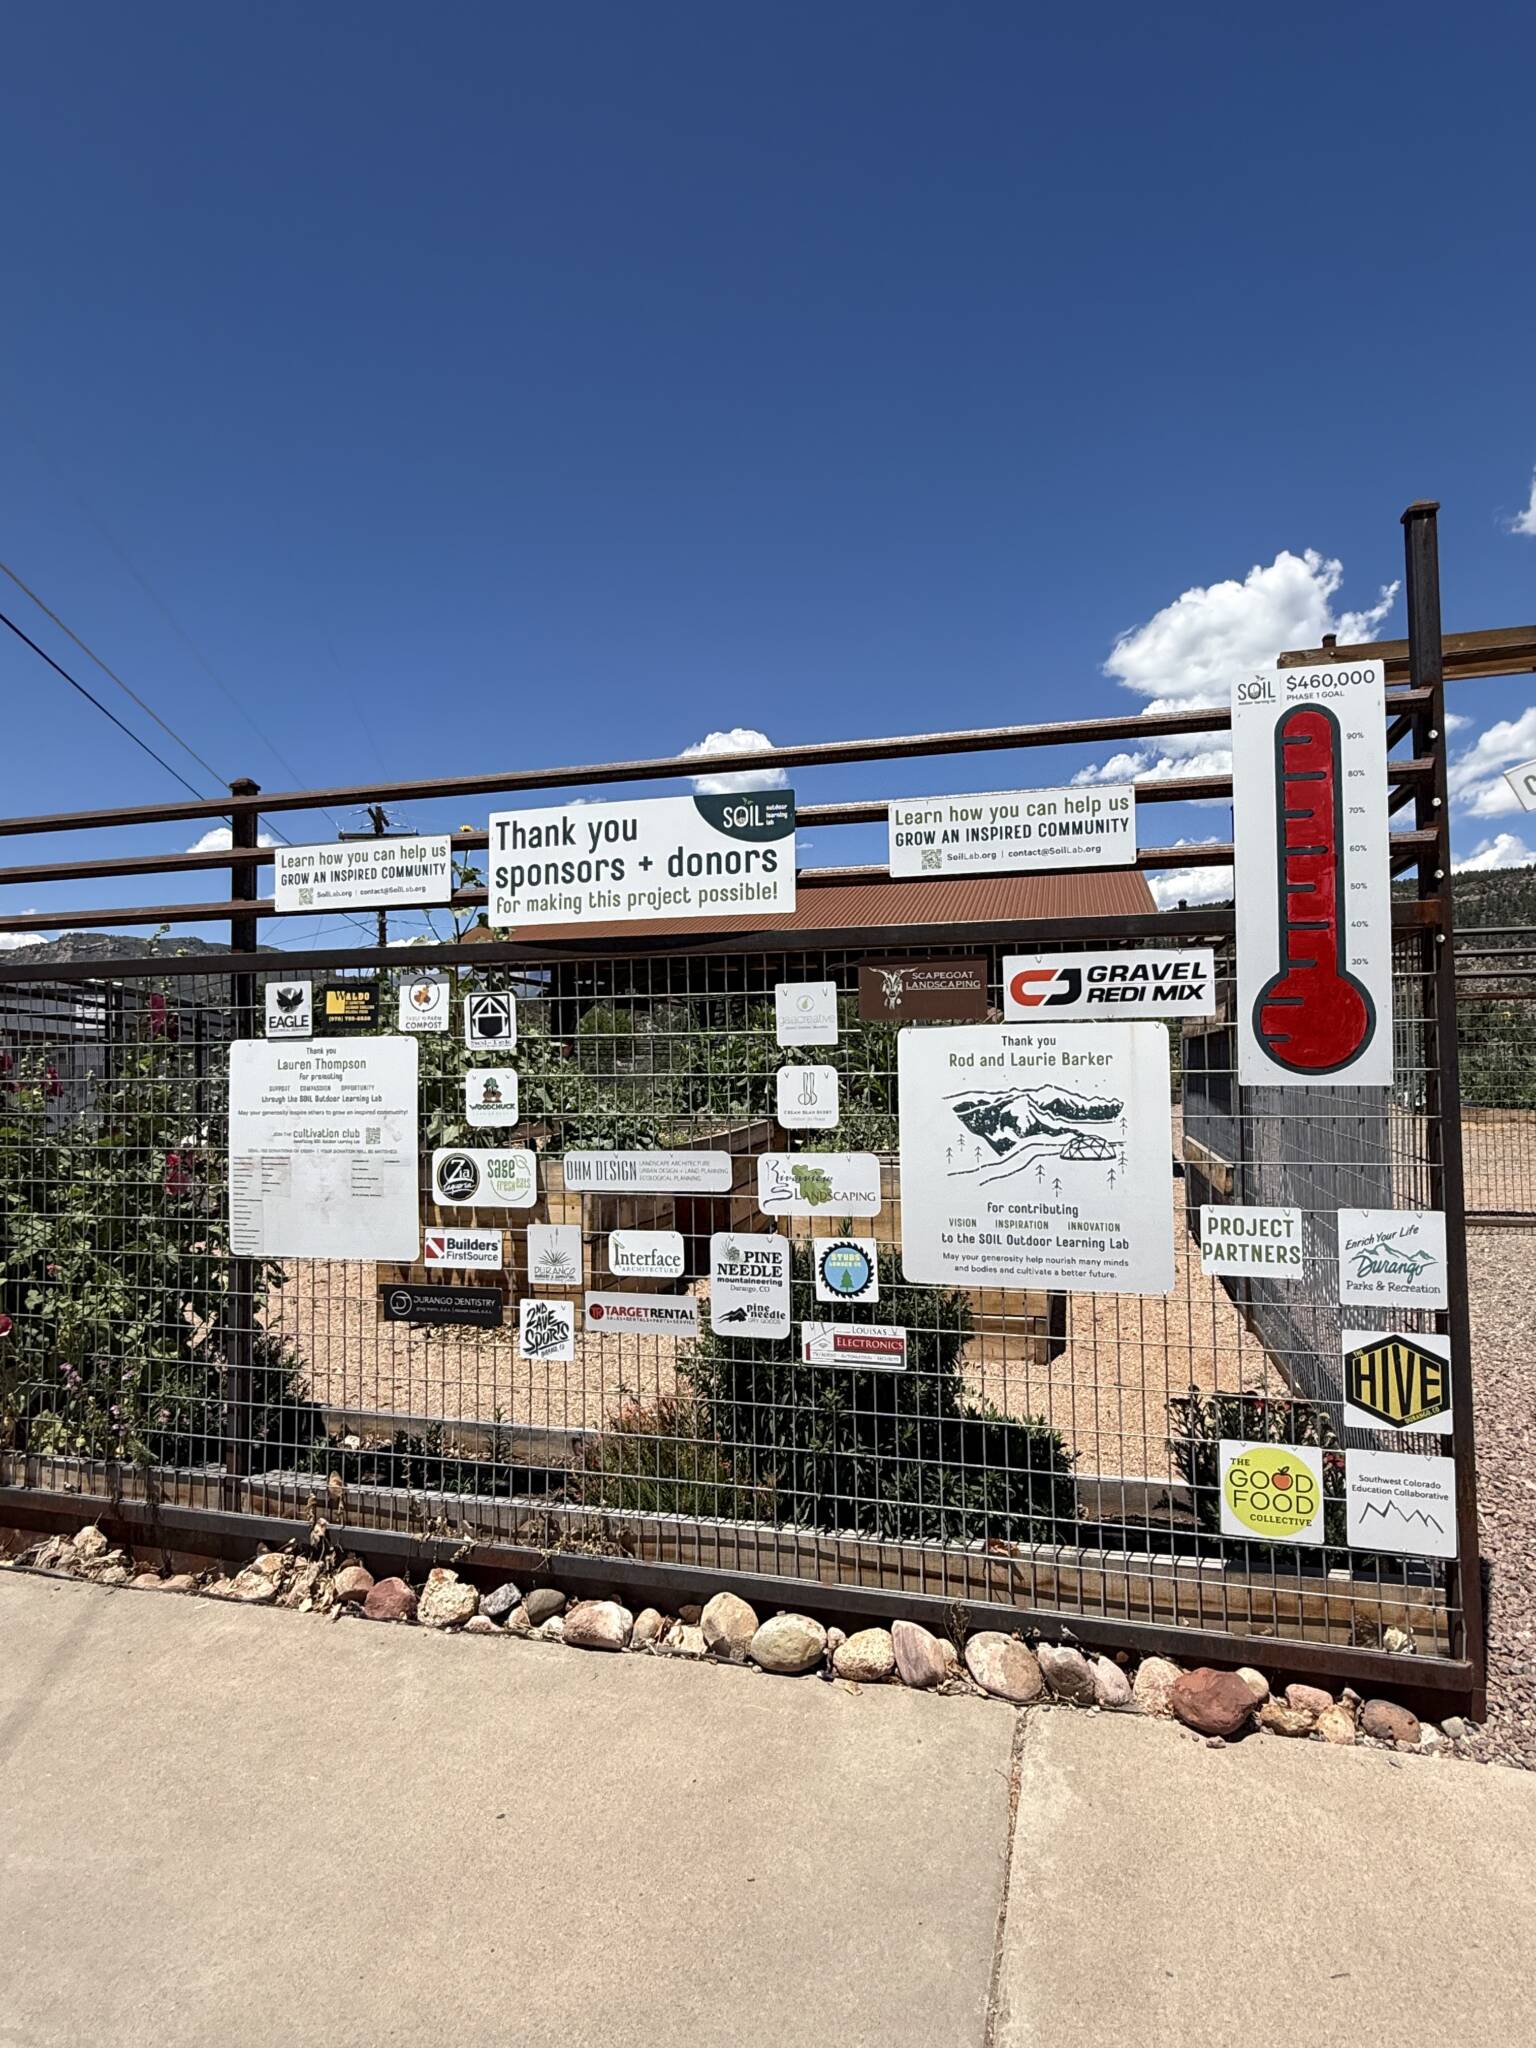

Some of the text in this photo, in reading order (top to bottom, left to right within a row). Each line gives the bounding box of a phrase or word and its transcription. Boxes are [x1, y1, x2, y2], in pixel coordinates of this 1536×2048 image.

[1286, 669, 1375, 691] $460,000
[1238, 681, 1276, 700] SOIL
[1347, 732, 1364, 740] 90%
[723, 806, 764, 828] SOIL
[896, 796, 1129, 826] Learn how you can help us
[495, 816, 638, 854] Thank you
[896, 818, 1129, 847] GROW AN INSPIRED COMMUNITY
[281, 845, 446, 868] Learn how you can help us
[947, 845, 1101, 861] SoilLab.org contact@SoilLab.org
[281, 863, 446, 886] GROW AN INSPIRED COMMUNITY
[495, 847, 778, 896] sponsors + donors
[496, 882, 778, 915] for making this project possible!
[912, 971, 974, 979] SCAPEGOAT
[1087, 962, 1207, 982] GRAVEL
[906, 980, 980, 988] LANDSCAPING
[336, 991, 370, 1000] WALDO
[1087, 985, 1205, 1003] REDI MIX
[269, 1015, 309, 1028] EAGLE
[1001, 1036, 1056, 1048] Thank you
[278, 1058, 366, 1072] Lauren Thompson
[949, 1052, 1113, 1066] Rod and Laurie Barker
[311, 1073, 342, 1081] promoting
[293, 1128, 360, 1138] cultivation club
[488, 1159, 516, 1178] sage
[566, 1160, 636, 1180] DHM DESIGN
[794, 1188, 876, 1201] LANDSCAPING
[987, 1202, 1079, 1218] for contributing
[949, 1218, 1120, 1232] VISION INSPIRATION INNOVATION
[1208, 1217, 1294, 1238] PROJECT
[447, 1238, 498, 1251] Builders
[942, 1233, 1129, 1252] to the SOIL Outdoor Learning Lab
[1345, 1225, 1419, 1250] Enrich Your Life
[447, 1251, 498, 1261] FirstSource
[614, 1243, 681, 1267] Interface
[744, 1251, 783, 1264] PINE
[943, 1253, 960, 1262] May
[981, 1255, 1023, 1264] generosity
[1026, 1255, 1043, 1265] help
[1046, 1256, 1076, 1265] nourish
[1079, 1258, 1100, 1267] many
[1103, 1258, 1128, 1267] minds
[1202, 1243, 1300, 1264] PARTNERS
[534, 1266, 576, 1275] DURANGO
[717, 1264, 783, 1277] NEEDLE
[971, 1265, 997, 1274] bodies
[1017, 1267, 1052, 1276] cultivate
[1061, 1269, 1086, 1277] better
[1089, 1269, 1117, 1278] future.
[1357, 1255, 1427, 1284] Durango
[717, 1277, 783, 1287] mountaineering
[730, 1284, 756, 1293] Durango,
[1346, 1281, 1440, 1294] Parks & Recreation
[413, 1296, 495, 1306] DURANGO DENTISTRY
[747, 1303, 770, 1312] pine
[527, 1302, 548, 1326] 2ND
[533, 1309, 560, 1332] AVE
[605, 1306, 694, 1320] TARGETRENTAL
[751, 1311, 786, 1319] needle
[523, 1321, 569, 1355] SPORTS
[837, 1337, 903, 1350] ELECTRONICS
[1354, 1344, 1442, 1418] HIVE
[1432, 1406, 1441, 1416] CO
[1230, 1458, 1250, 1467] THE
[1230, 1465, 1313, 1493] GOOD
[1359, 1474, 1441, 1490] Southwest Colorado
[1352, 1485, 1449, 1501] Education Collaborative
[1233, 1490, 1314, 1514] FOOD
[1250, 1514, 1312, 1527] COLLECTIVE
